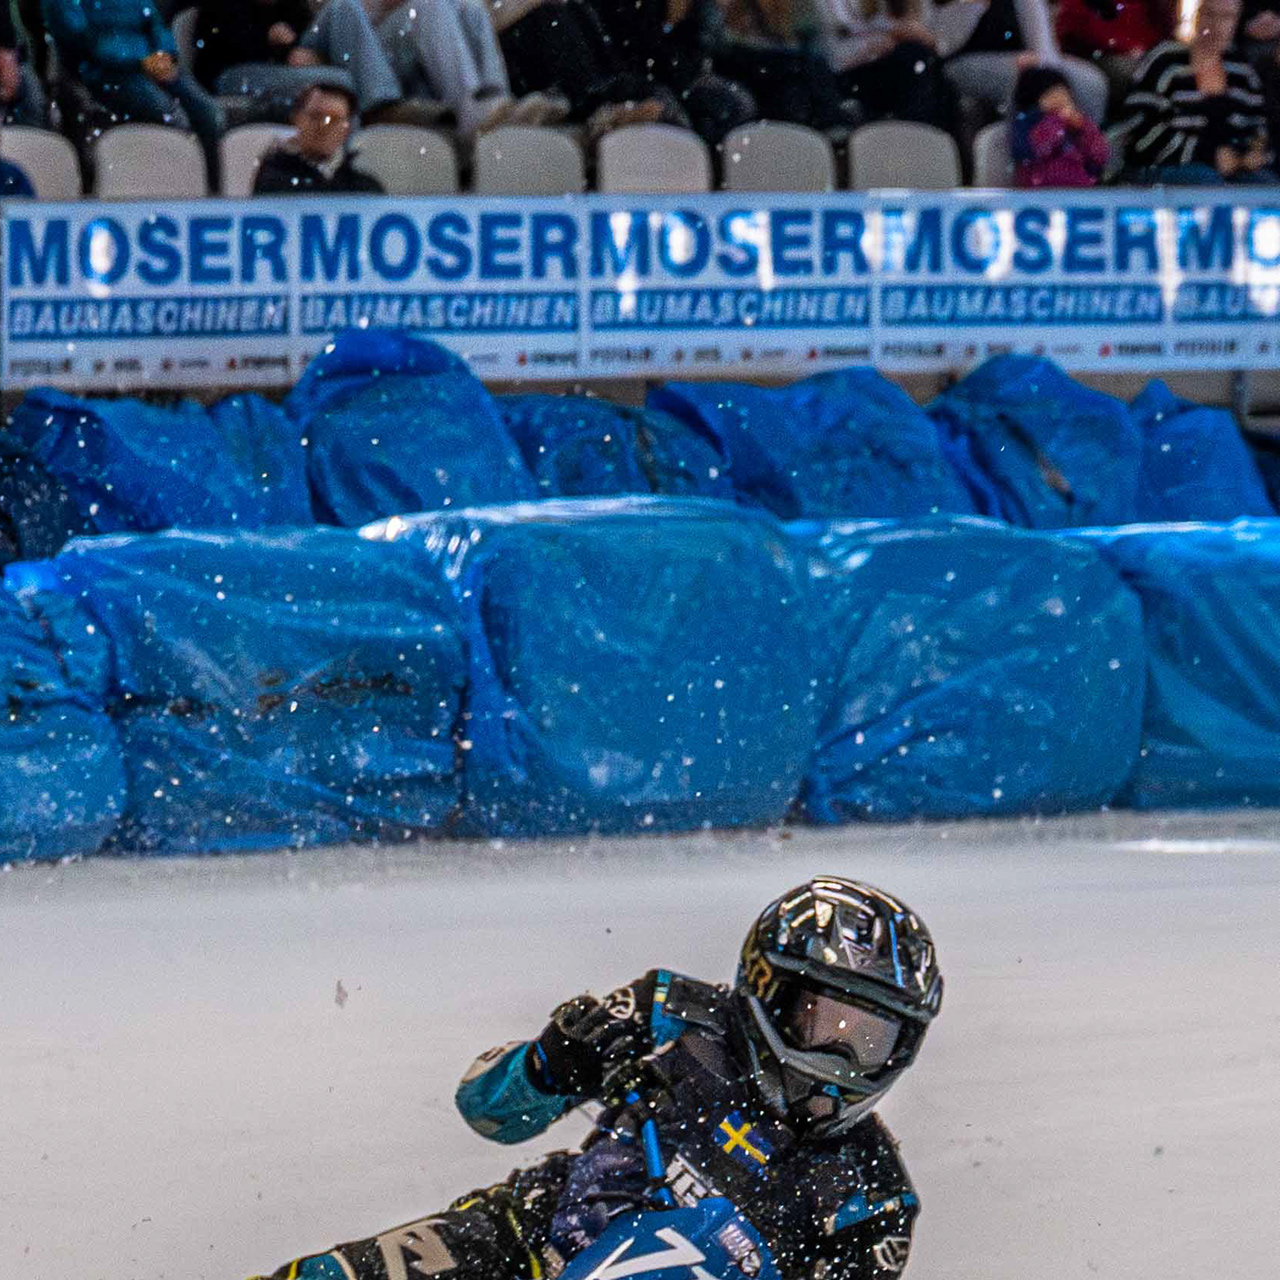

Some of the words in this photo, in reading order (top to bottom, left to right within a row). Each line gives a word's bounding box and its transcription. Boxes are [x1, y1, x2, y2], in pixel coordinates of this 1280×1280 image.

[9, 216, 289, 287] MOSER
[300, 211, 579, 282] MOSER
[591, 209, 871, 277] MOSER
[880, 208, 1159, 273] MOSER
[11, 300, 289, 336] BAUMASCHINEN
[301, 296, 577, 330] BAUMASCHINEN
[592, 292, 869, 323] BAUMASCHINEN
[882, 289, 1162, 320] BAUMASCHINEN
